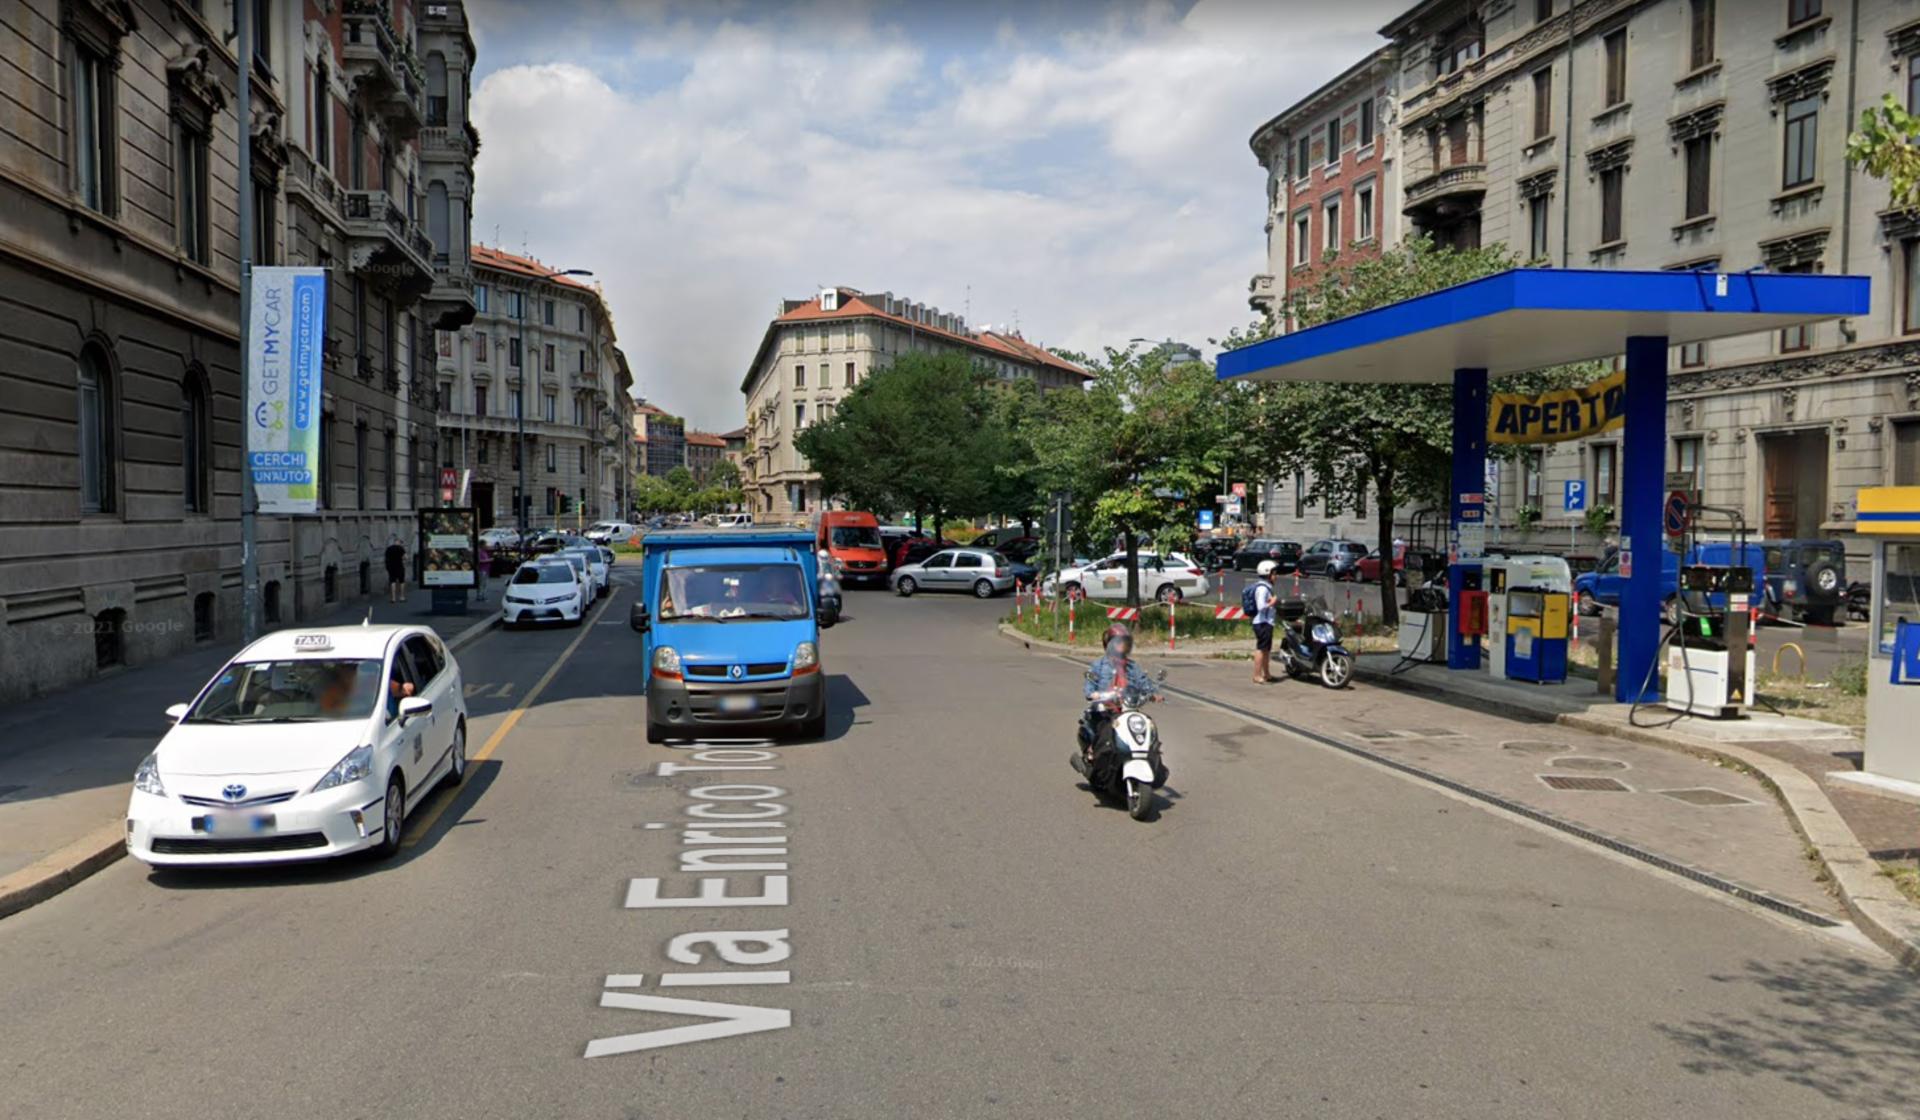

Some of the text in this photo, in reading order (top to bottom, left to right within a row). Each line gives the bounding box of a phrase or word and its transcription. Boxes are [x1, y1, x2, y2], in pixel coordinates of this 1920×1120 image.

[262, 287, 282, 395] GETMYCAR
[297, 291, 312, 423] www.getmycar.com
[1495, 385, 1626, 435] APERTO
[254, 453, 305, 466] CERCHI
[254, 470, 312, 483] UN'AUTO?
[441, 472, 456, 485] M
[1568, 482, 1582, 496] P
[295, 635, 328, 646] TAXI
